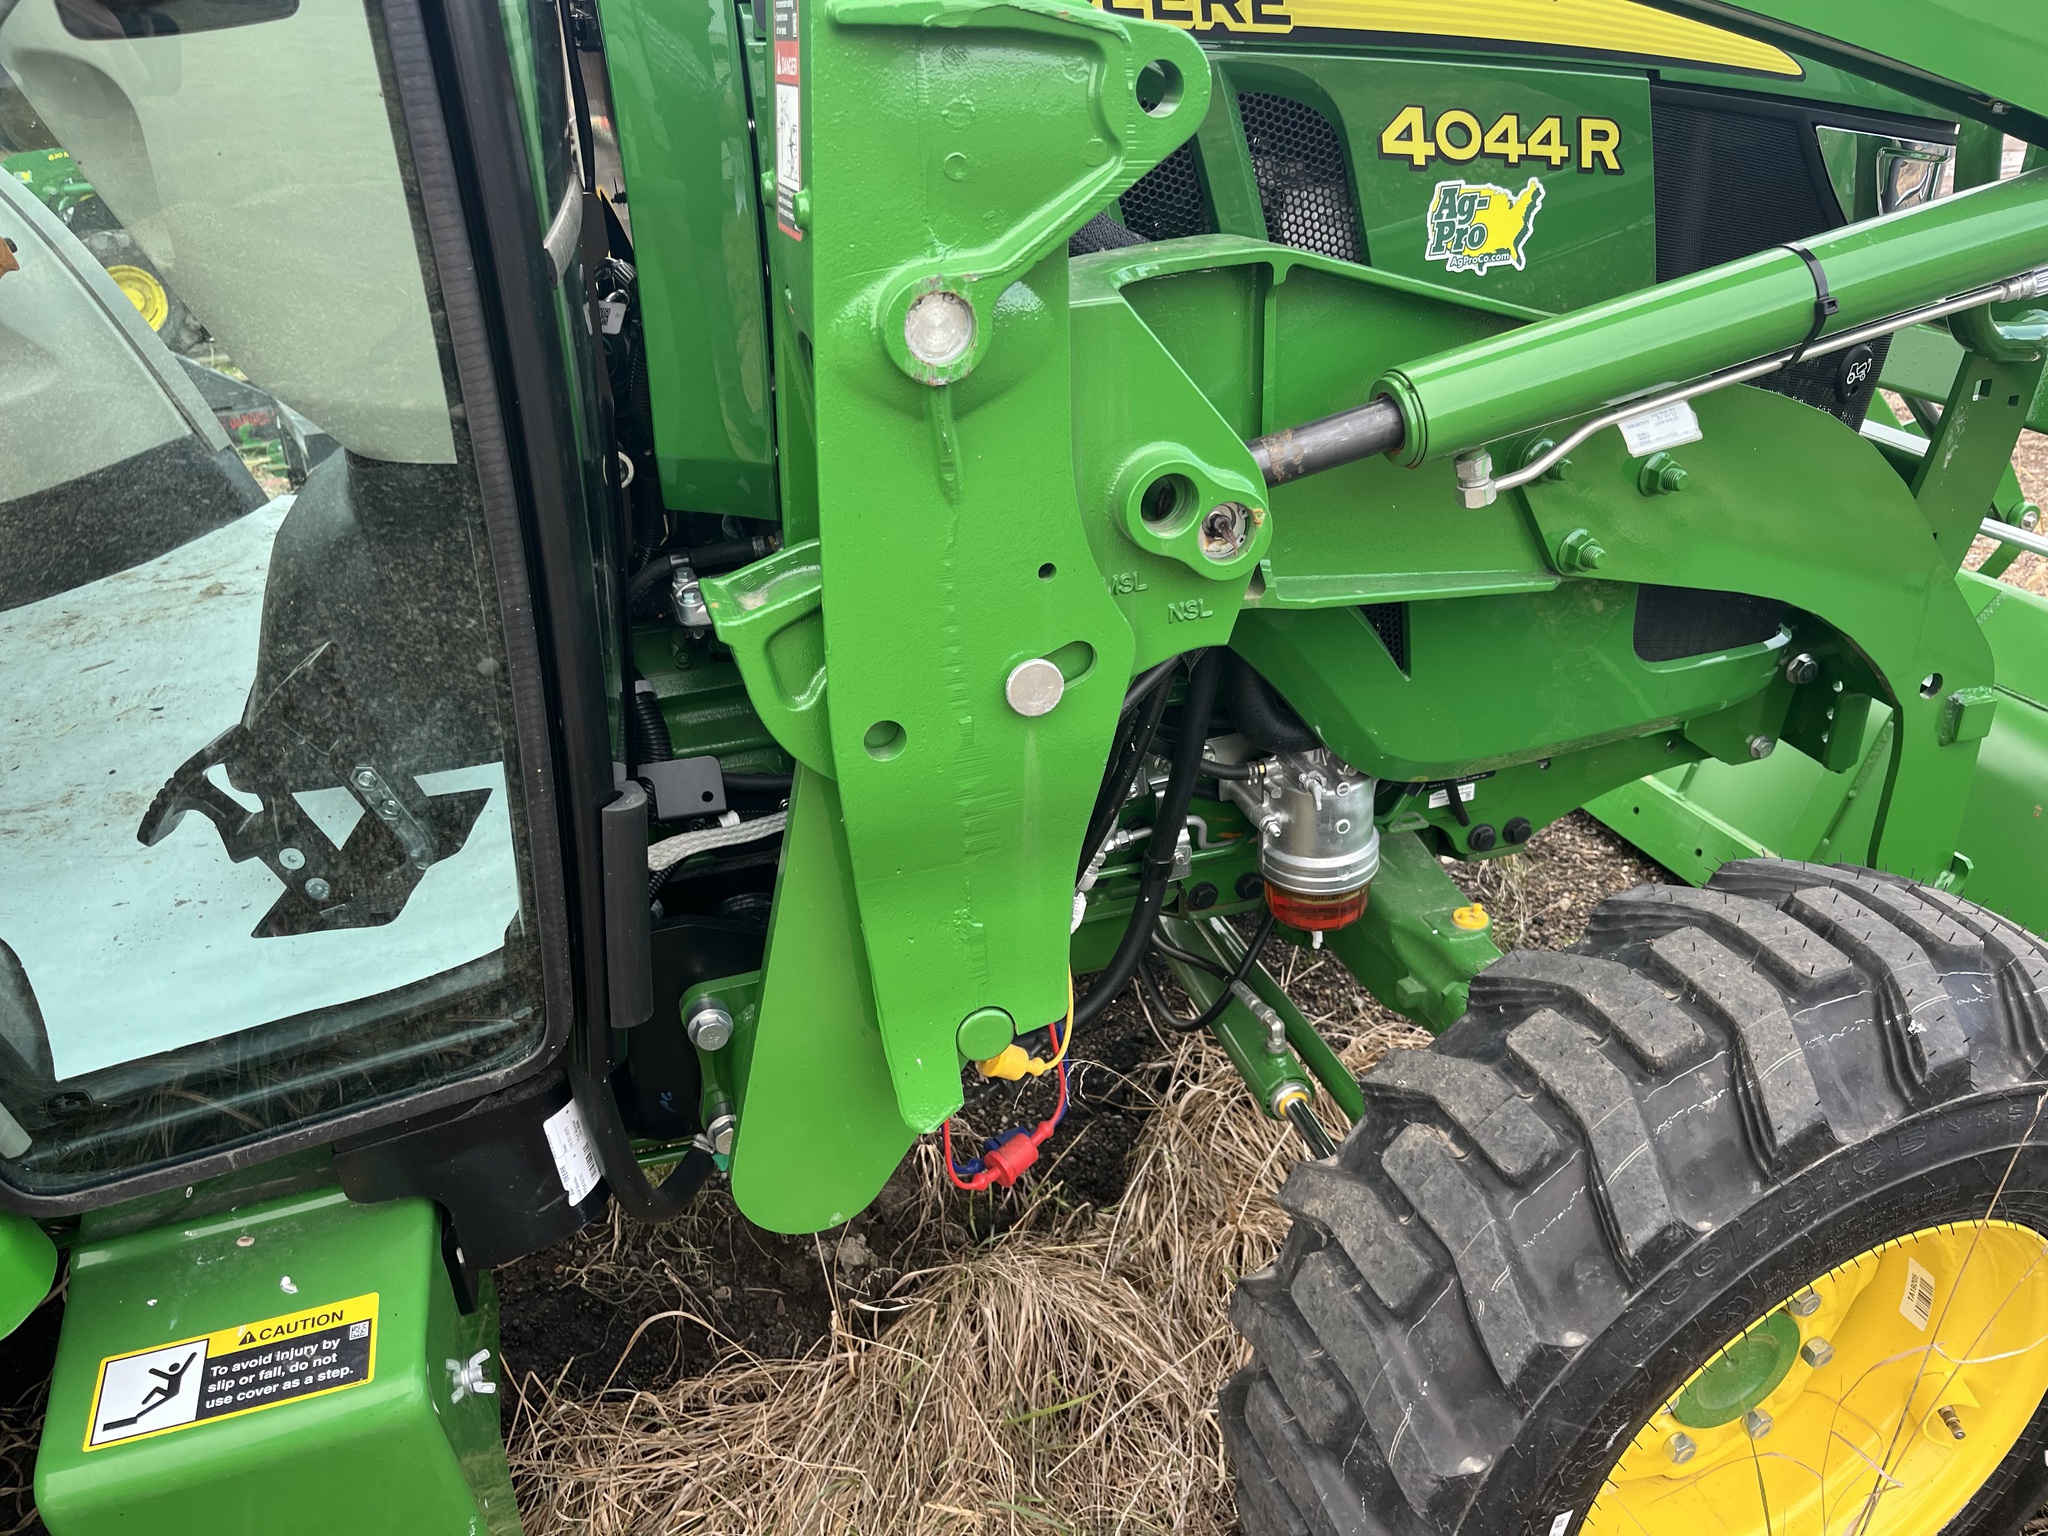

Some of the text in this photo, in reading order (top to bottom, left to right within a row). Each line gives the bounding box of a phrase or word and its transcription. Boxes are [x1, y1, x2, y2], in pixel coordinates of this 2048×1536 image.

[1433, 185, 1490, 225] Ag-
[1430, 221, 1487, 255] Pro
[1450, 252, 1511, 267] AgProCo.com
[1168, 598, 1213, 624] NSL
[259, 1310, 344, 1340] CAUTION
[207, 1353, 338, 1393] slip or fall, do not
[210, 1338, 341, 1377] To avoid injury by
[205, 1366, 354, 1409] use cover as a step.
